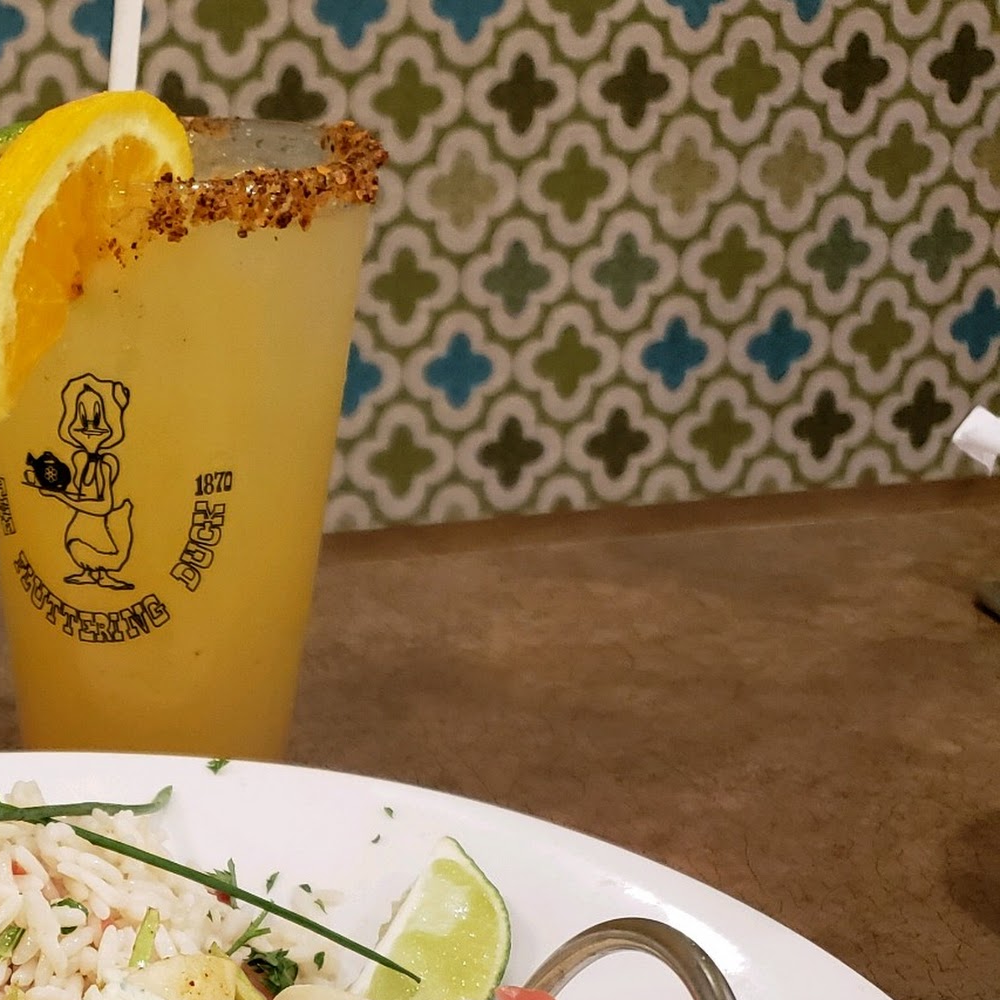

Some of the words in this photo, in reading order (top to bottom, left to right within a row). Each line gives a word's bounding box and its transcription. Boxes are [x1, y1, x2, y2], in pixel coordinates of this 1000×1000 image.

[194, 471, 233, 496] 1870
[13, 550, 171, 643] FLUTTERING
[169, 500, 226, 592] DUCK
